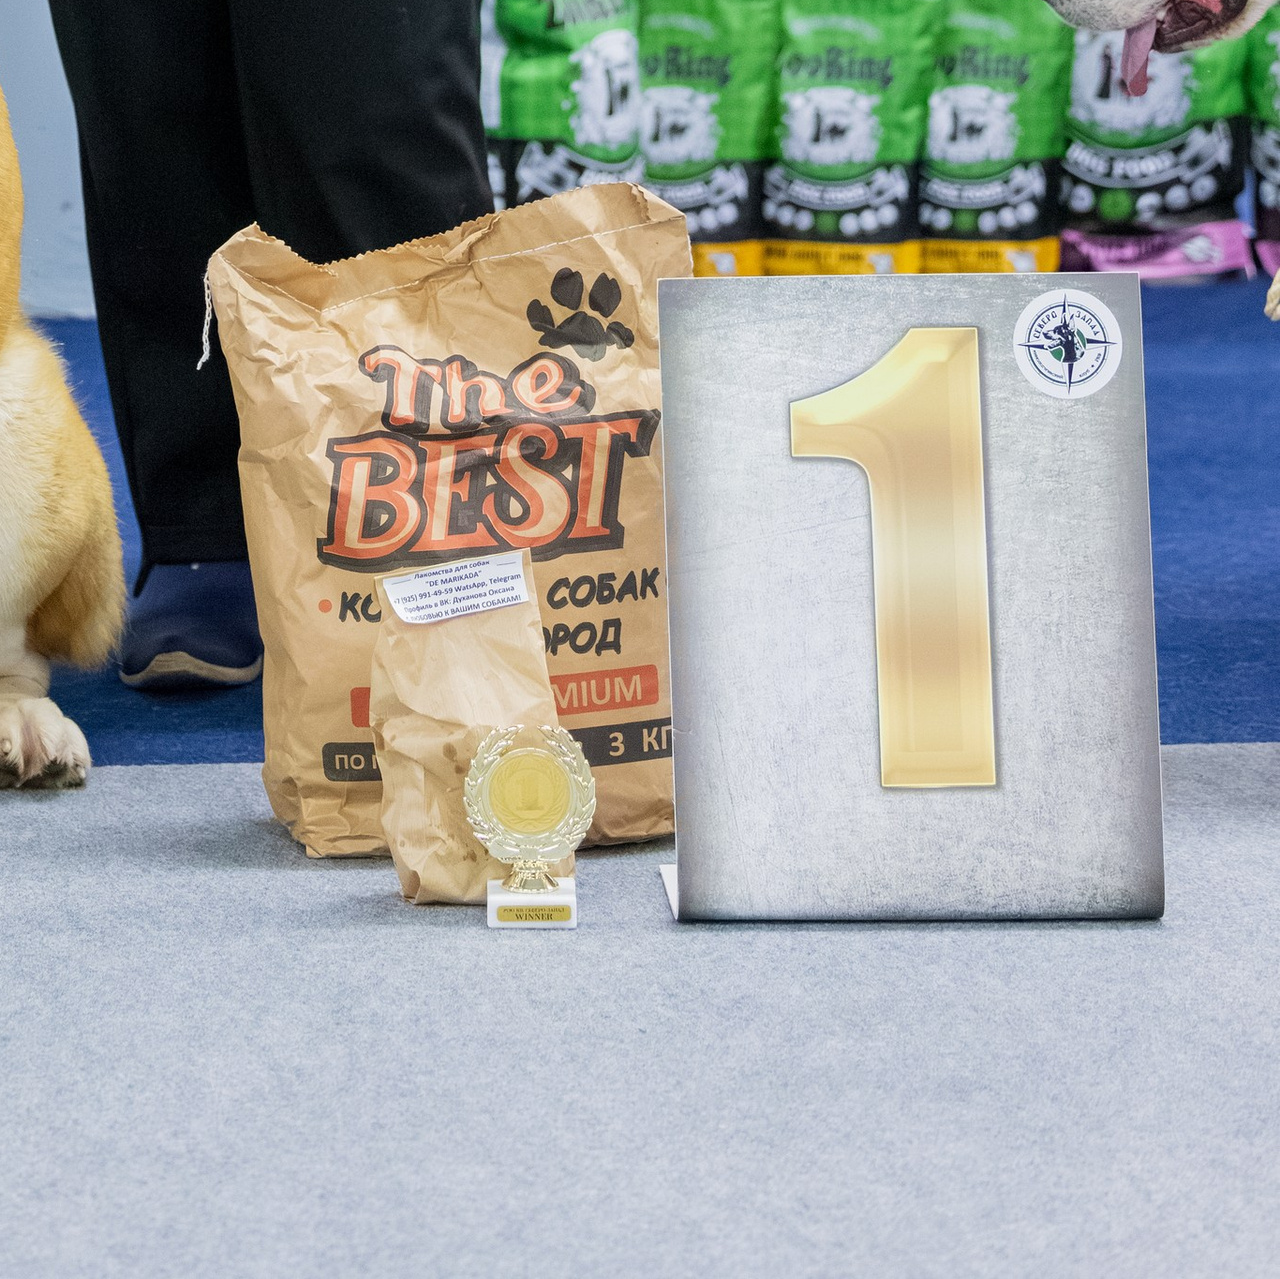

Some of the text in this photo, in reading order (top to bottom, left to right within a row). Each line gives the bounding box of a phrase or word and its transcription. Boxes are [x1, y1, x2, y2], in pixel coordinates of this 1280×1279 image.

[362, 347, 588, 429] The
[320, 413, 652, 561] BEST
[413, 560, 490, 580] Лакомства для собак
[788, 325, 997, 788] 1
[401, 594, 418, 605] (925)
[418, 587, 453, 600] 991-49-59
[489, 573, 522, 584] Telegram
[425, 570, 482, 588] "DE MARIKADA"
[546, 567, 660, 610] СОБАК
[450, 603, 481, 616] ВАШИМ
[481, 593, 522, 609] СОБАКАМ!
[452, 592, 487, 605] Духанова
[488, 585, 515, 596] Оксана
[552, 674, 642, 709] MIUM
[608, 731, 625, 758] 3
[334, 754, 366, 770] ПО
[515, 912, 554, 921] WINNER
